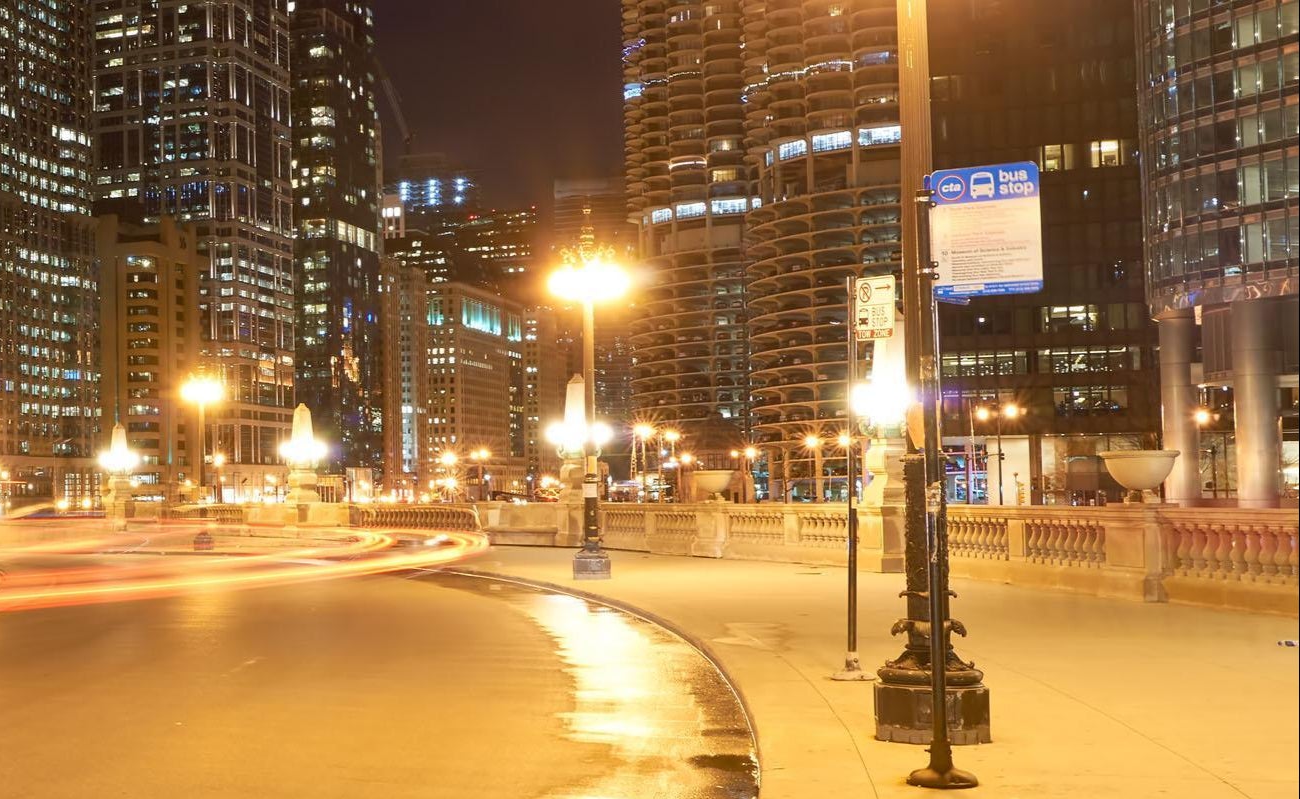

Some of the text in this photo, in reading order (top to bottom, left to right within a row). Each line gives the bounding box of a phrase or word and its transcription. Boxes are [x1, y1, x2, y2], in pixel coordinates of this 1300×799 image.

[999, 169, 1028, 183] bus
[941, 182, 961, 193] cta
[999, 180, 1034, 196] stop
[871, 306, 885, 317] BUS
[871, 316, 889, 328] STOP
